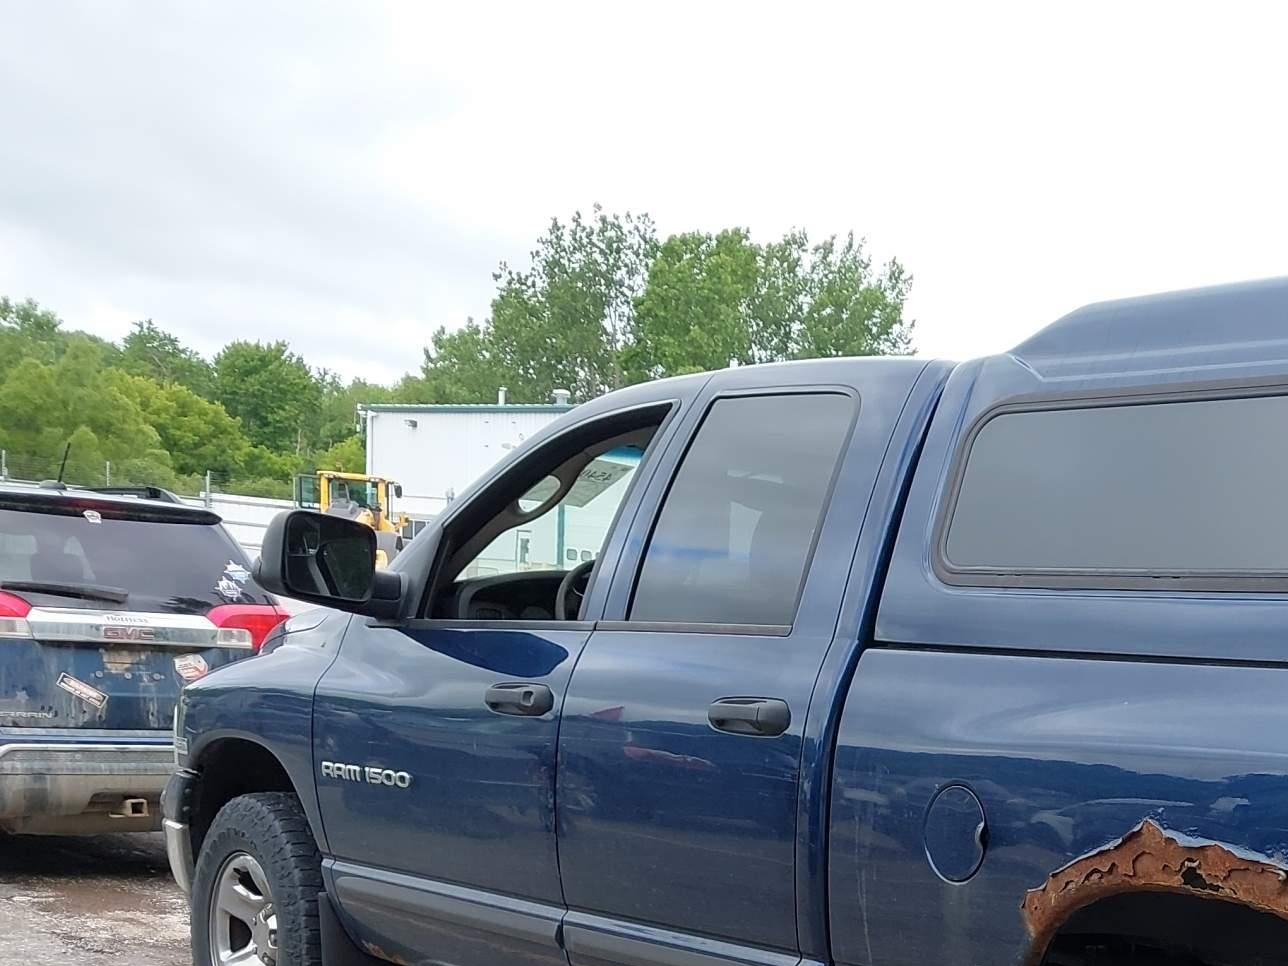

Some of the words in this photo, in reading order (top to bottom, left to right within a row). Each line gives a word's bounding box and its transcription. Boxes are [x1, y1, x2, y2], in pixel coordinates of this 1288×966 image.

[103, 626, 153, 641] GMC
[321, 761, 361, 782] RAM
[364, 766, 411, 788] 1500
